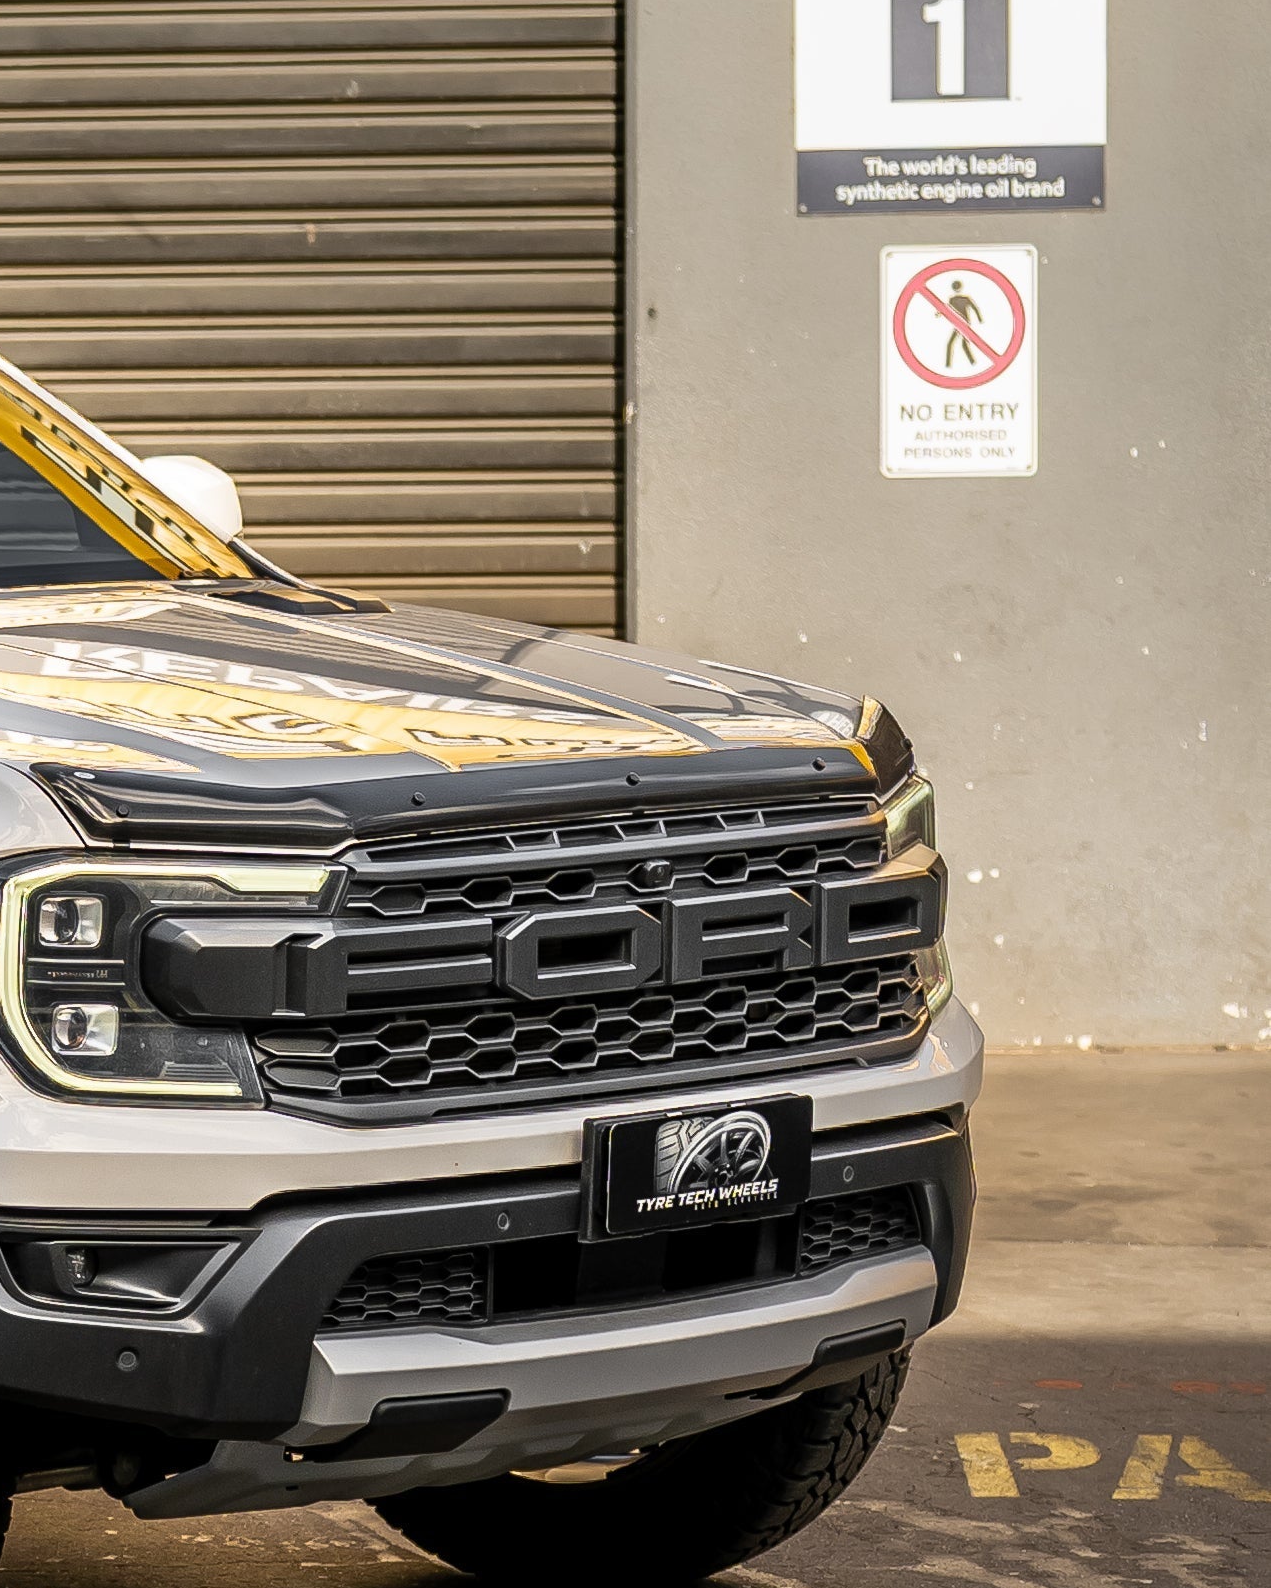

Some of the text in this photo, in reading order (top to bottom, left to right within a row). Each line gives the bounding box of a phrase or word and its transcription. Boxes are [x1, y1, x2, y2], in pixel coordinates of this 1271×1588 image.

[863, 154, 1037, 177] The world's leading
[835, 176, 1066, 205] synthetic engine oil brand
[899, 402, 1020, 422] NO ENTRY
[914, 429, 1008, 442] AUTHORISED
[903, 446, 1016, 459] PERSONS ONLY
[278, 865, 948, 1017] FORD
[635, 1178, 779, 1213] TYRE TECH WHEELS
